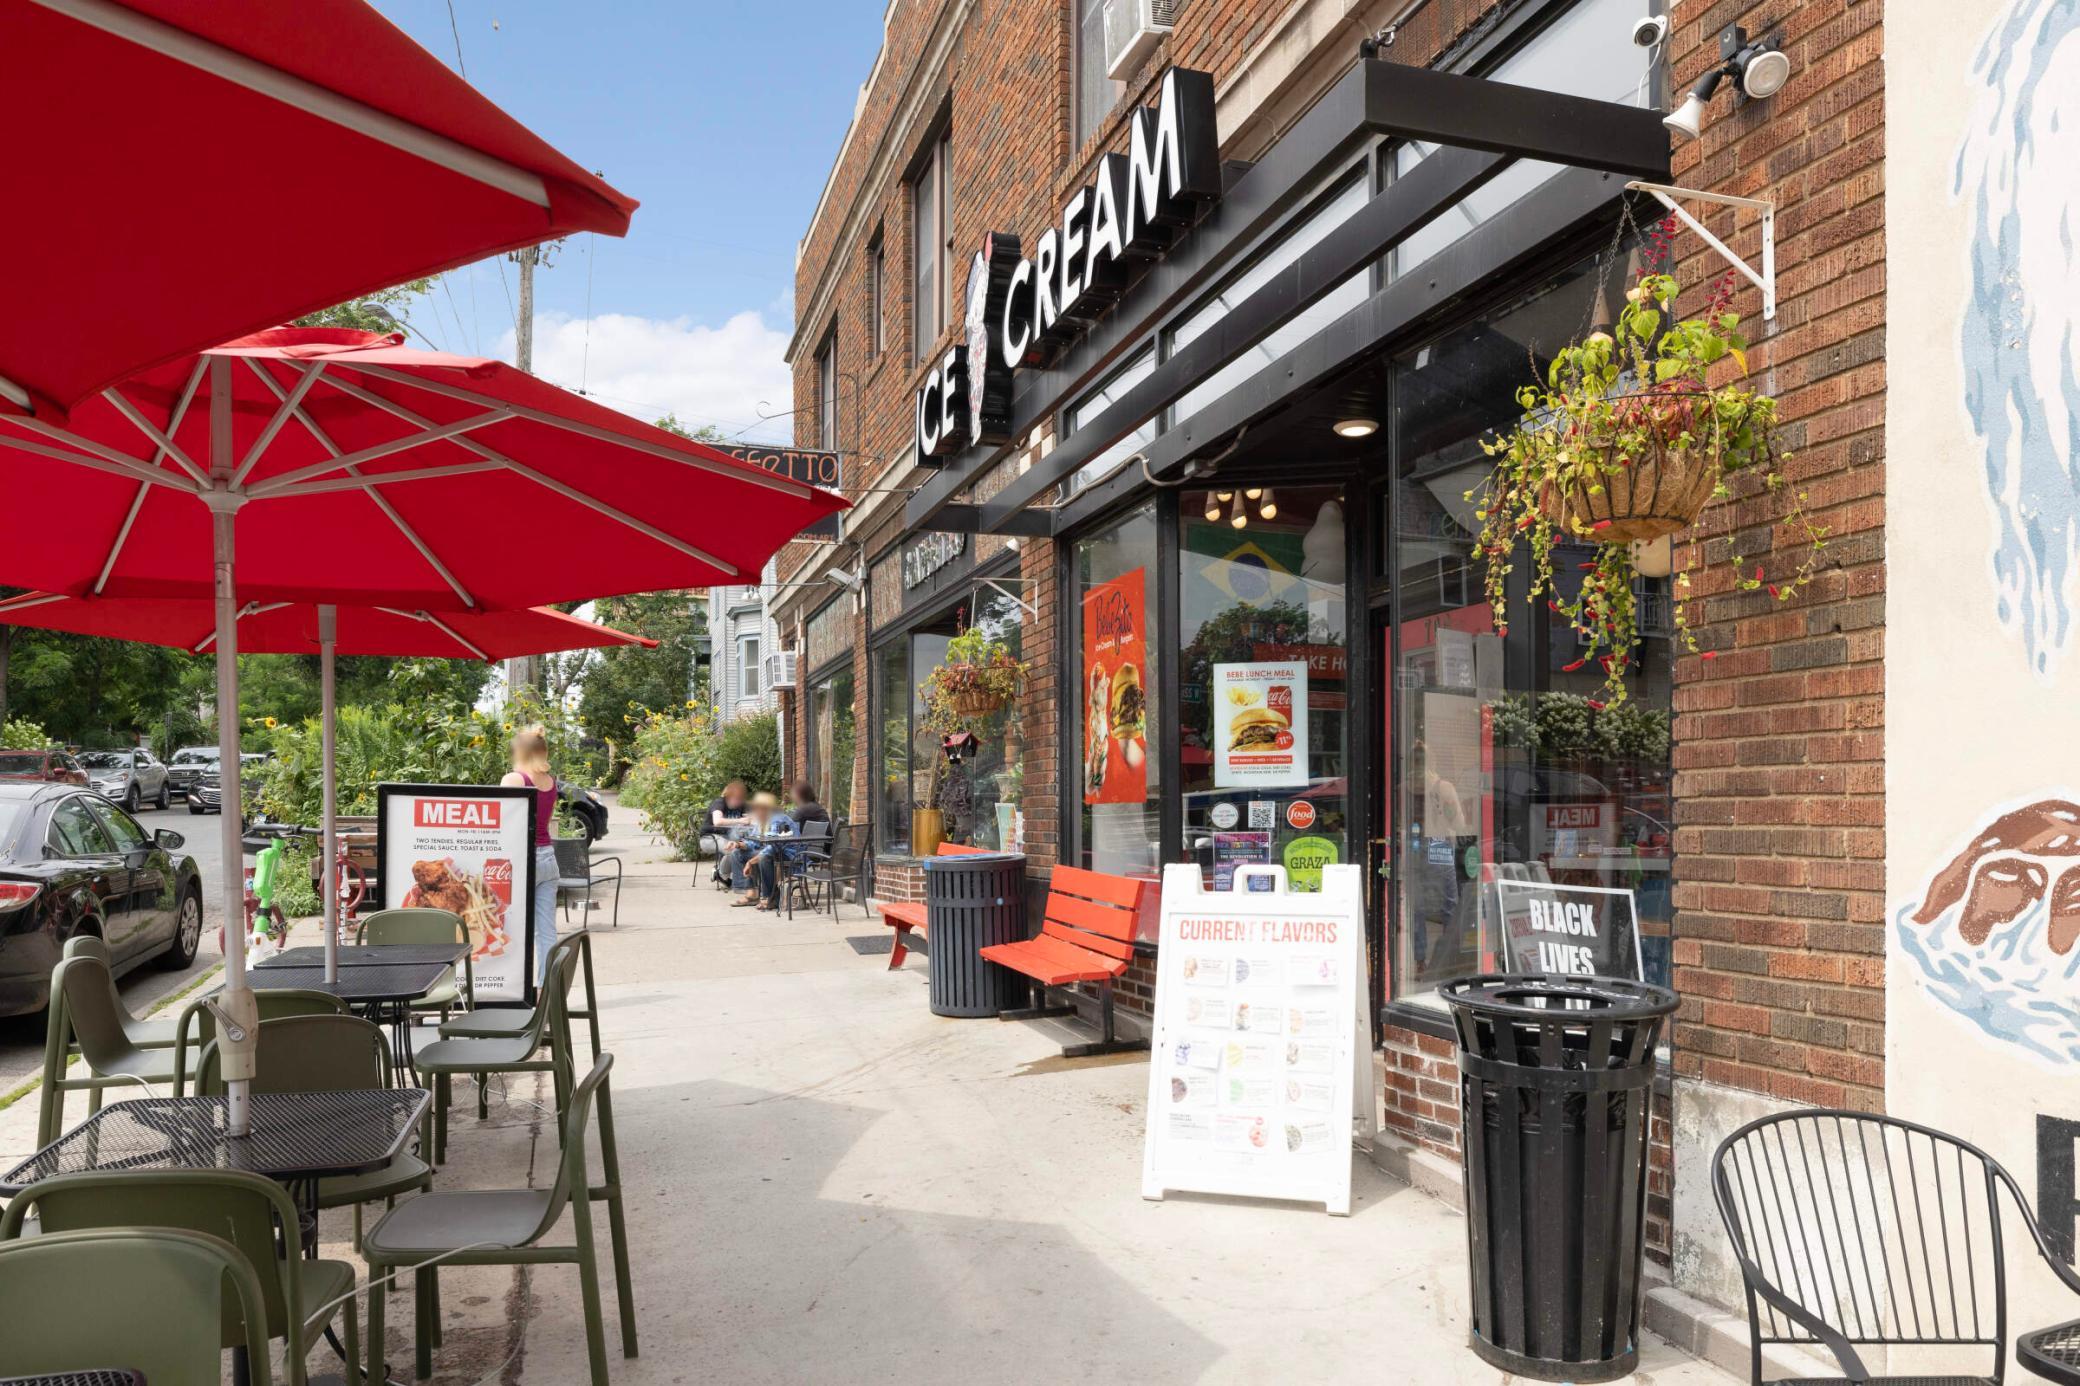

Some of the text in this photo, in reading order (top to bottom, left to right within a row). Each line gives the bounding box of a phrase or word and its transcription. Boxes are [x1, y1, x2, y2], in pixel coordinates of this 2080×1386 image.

[915, 346, 956, 467] ICE
[1003, 66, 1185, 368] CREAM
[1246, 669, 1272, 678] LUNCH
[1273, 669, 1296, 677] MEAL
[423, 802, 497, 826] MEAL
[1290, 807, 1313, 820] food
[1290, 856, 1331, 870] GRAZA
[1529, 898, 1598, 937] BLACK
[1180, 920, 1338, 944] CURRENT FLAVORS
[1538, 941, 1596, 975] LIVES
